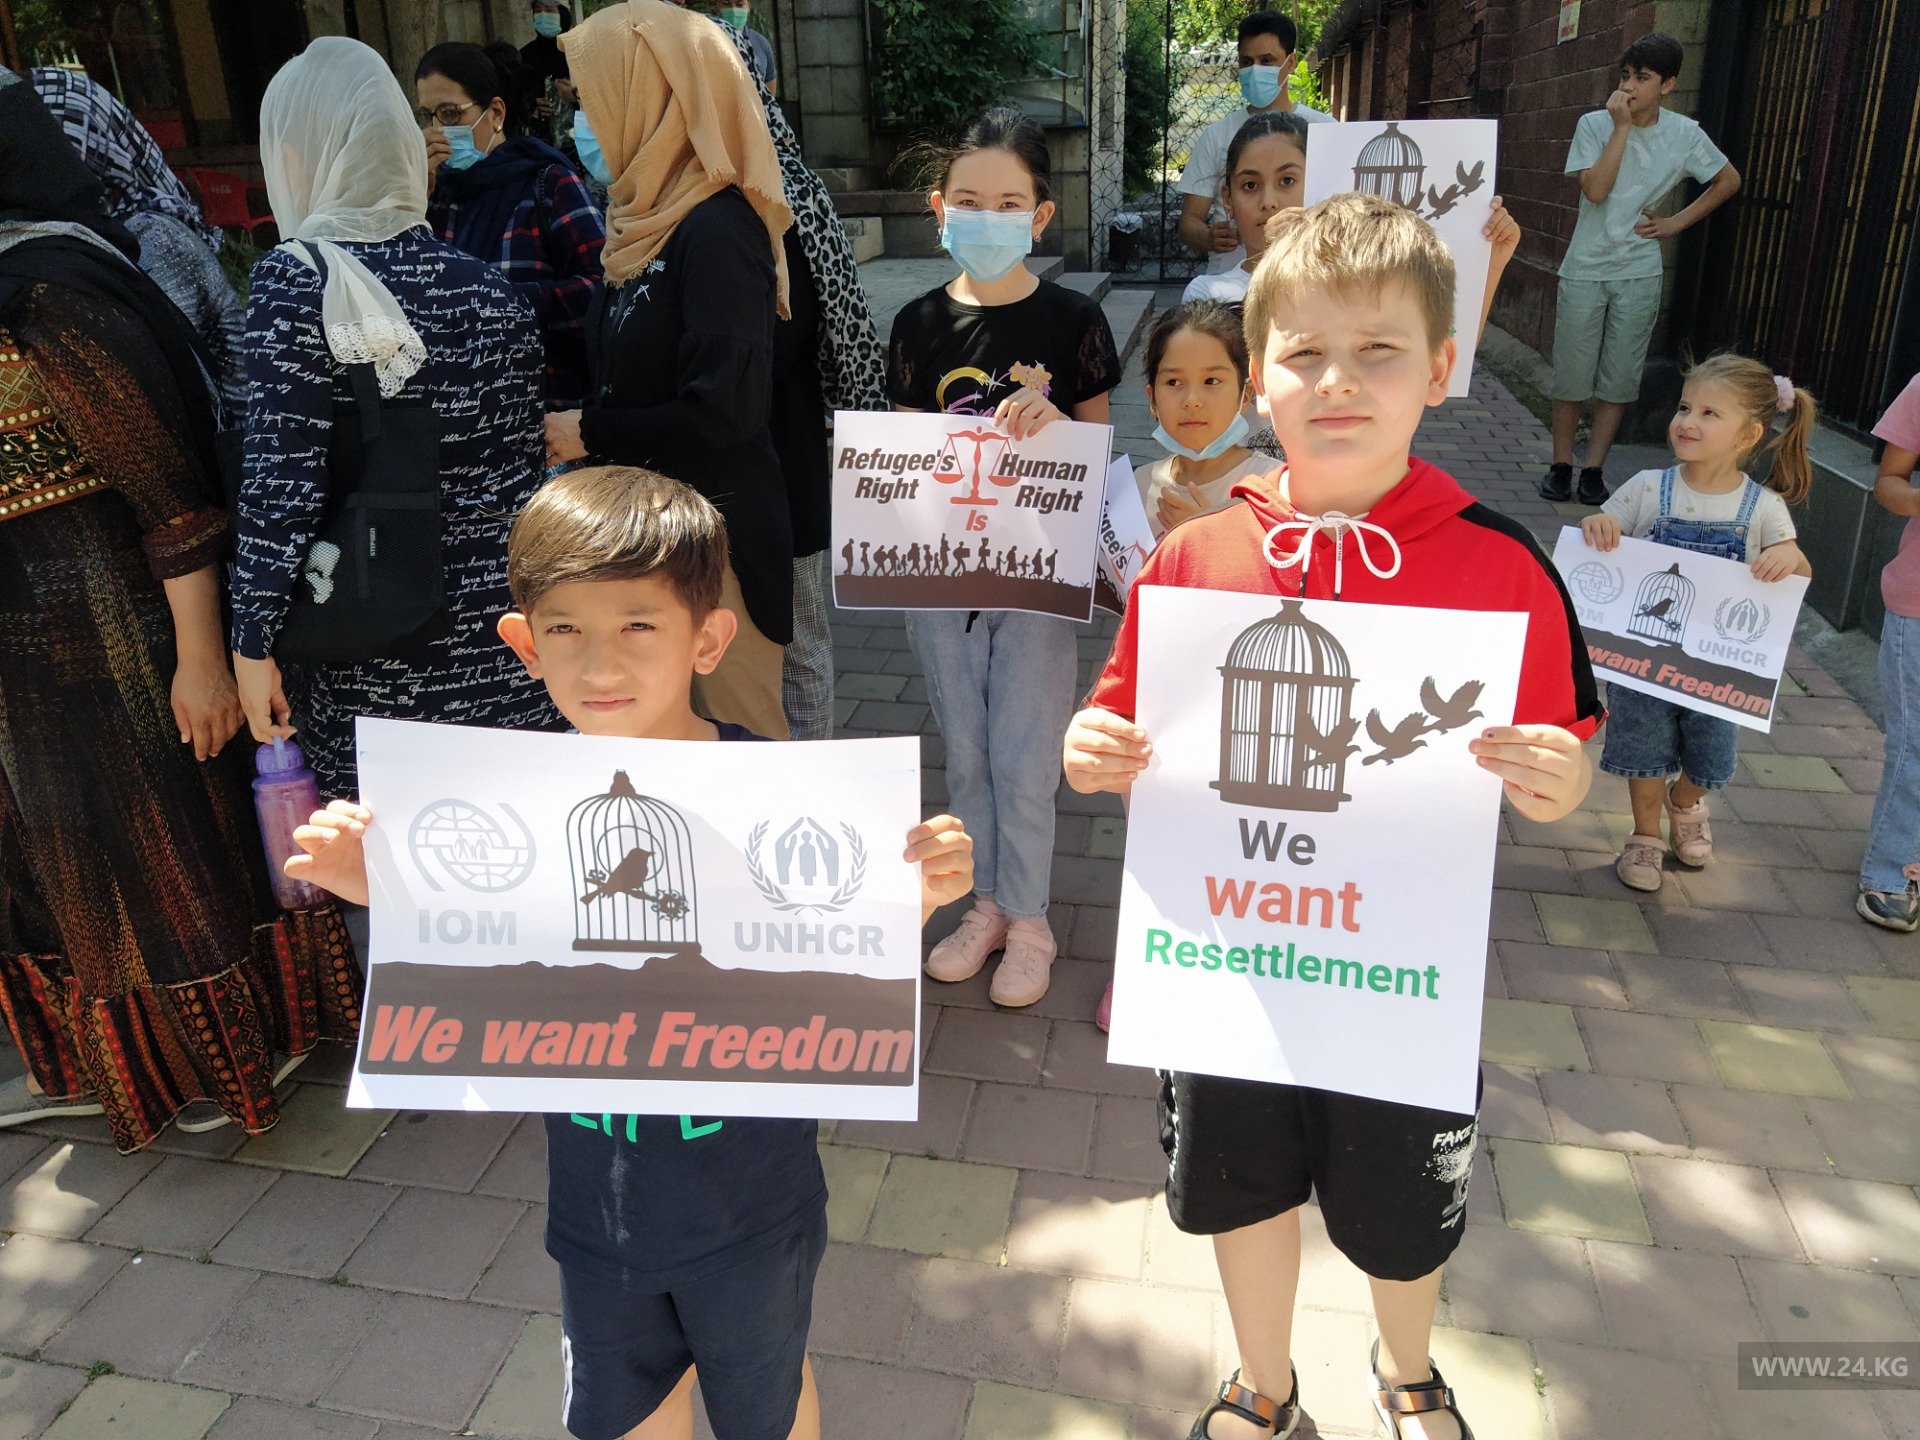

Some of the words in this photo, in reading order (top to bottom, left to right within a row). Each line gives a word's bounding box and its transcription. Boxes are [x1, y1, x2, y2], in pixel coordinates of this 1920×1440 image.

[838, 448, 955, 473] Refugee's
[997, 453, 1088, 483] Human
[854, 476, 920, 505] Right
[1014, 484, 1084, 514] Right
[965, 509, 988, 532] Is
[1697, 639, 1768, 668] UNHCR
[1655, 664, 1772, 716] Freedom
[1238, 817, 1317, 866] We
[1204, 875, 1363, 933] want
[417, 908, 518, 946] IOM
[734, 921, 886, 957] UNHCR
[1144, 928, 1441, 1000] Resettlement
[367, 1004, 464, 1063] We
[480, 1012, 640, 1068] want
[648, 1010, 915, 1074] Freedom
[1432, 1122, 1474, 1149] FAKE
